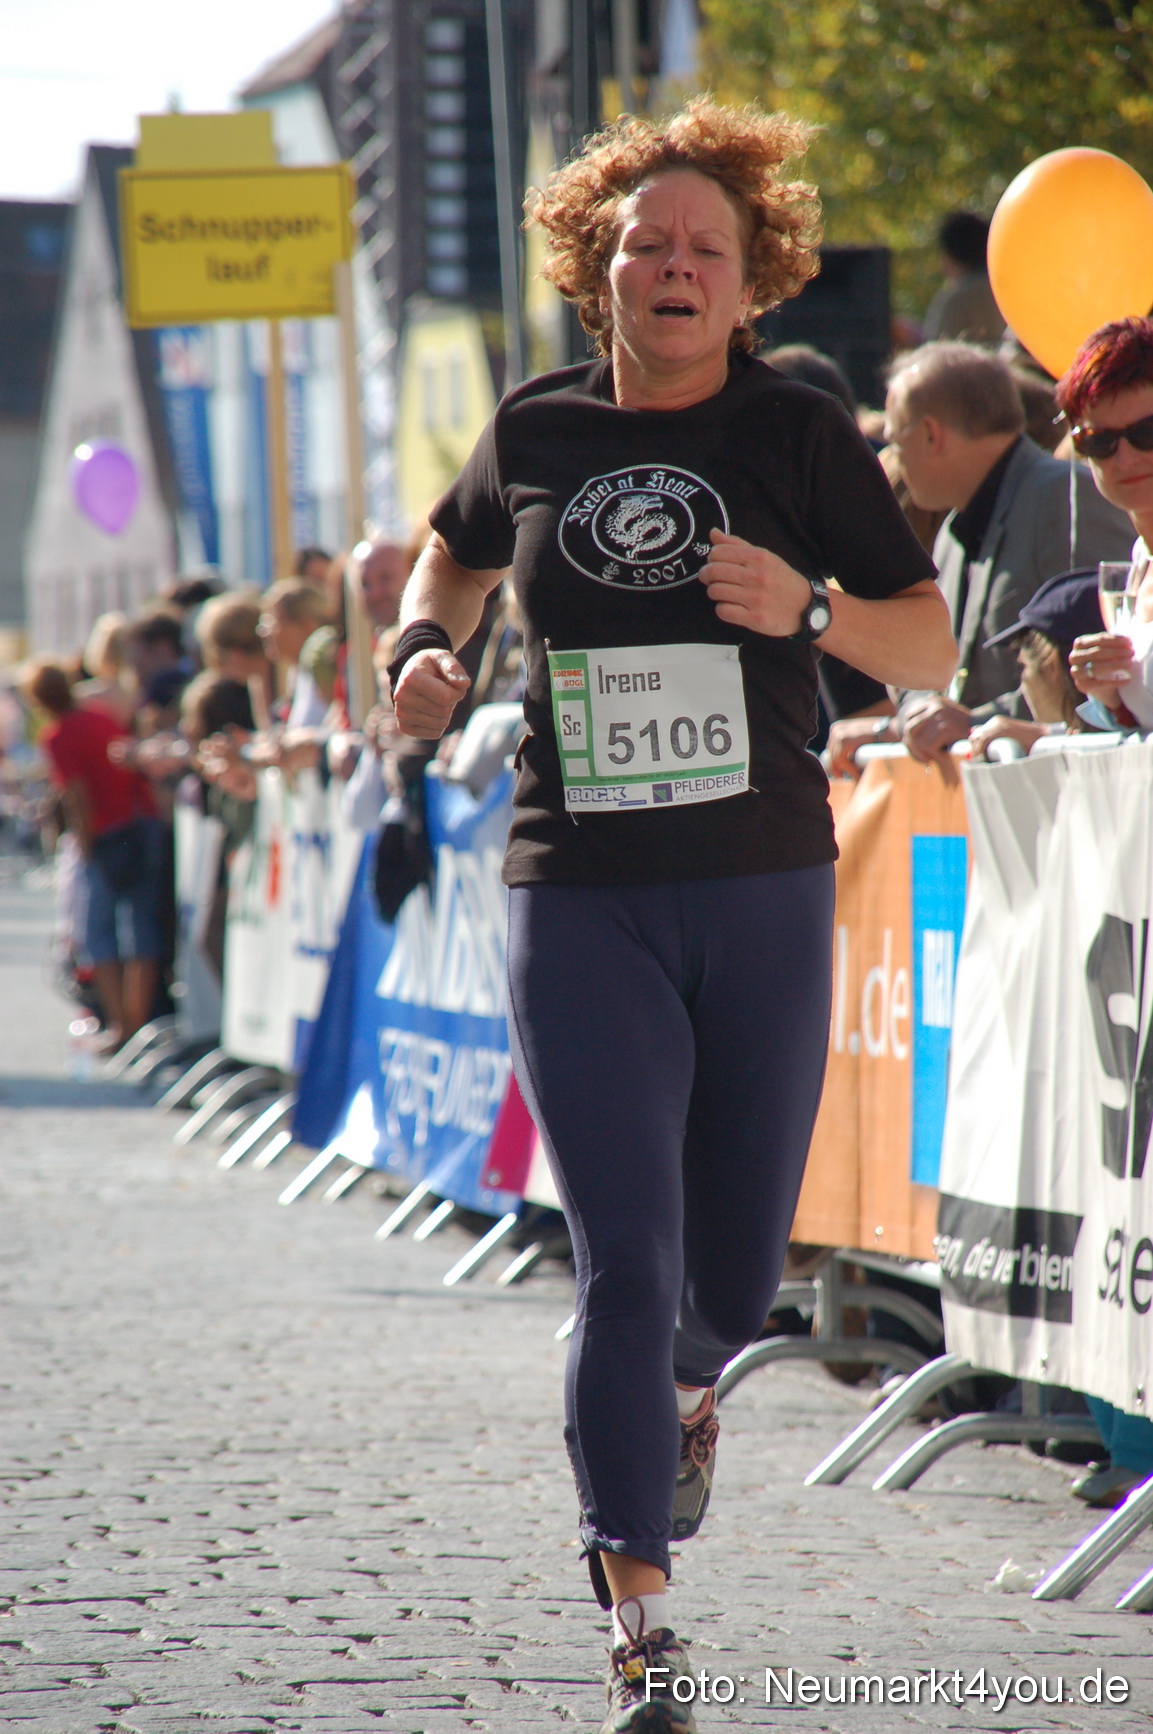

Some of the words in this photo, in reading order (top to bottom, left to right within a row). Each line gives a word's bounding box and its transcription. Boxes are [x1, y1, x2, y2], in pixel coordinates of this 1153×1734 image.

[205, 252, 271, 284] lauf
[646, 470, 702, 499] Heart
[632, 558, 688, 585] 2007
[597, 664, 661, 694] Irene
[607, 713, 732, 765] 5106
[567, 786, 628, 803] BOCK
[674, 772, 746, 794] PFLEIDERER
